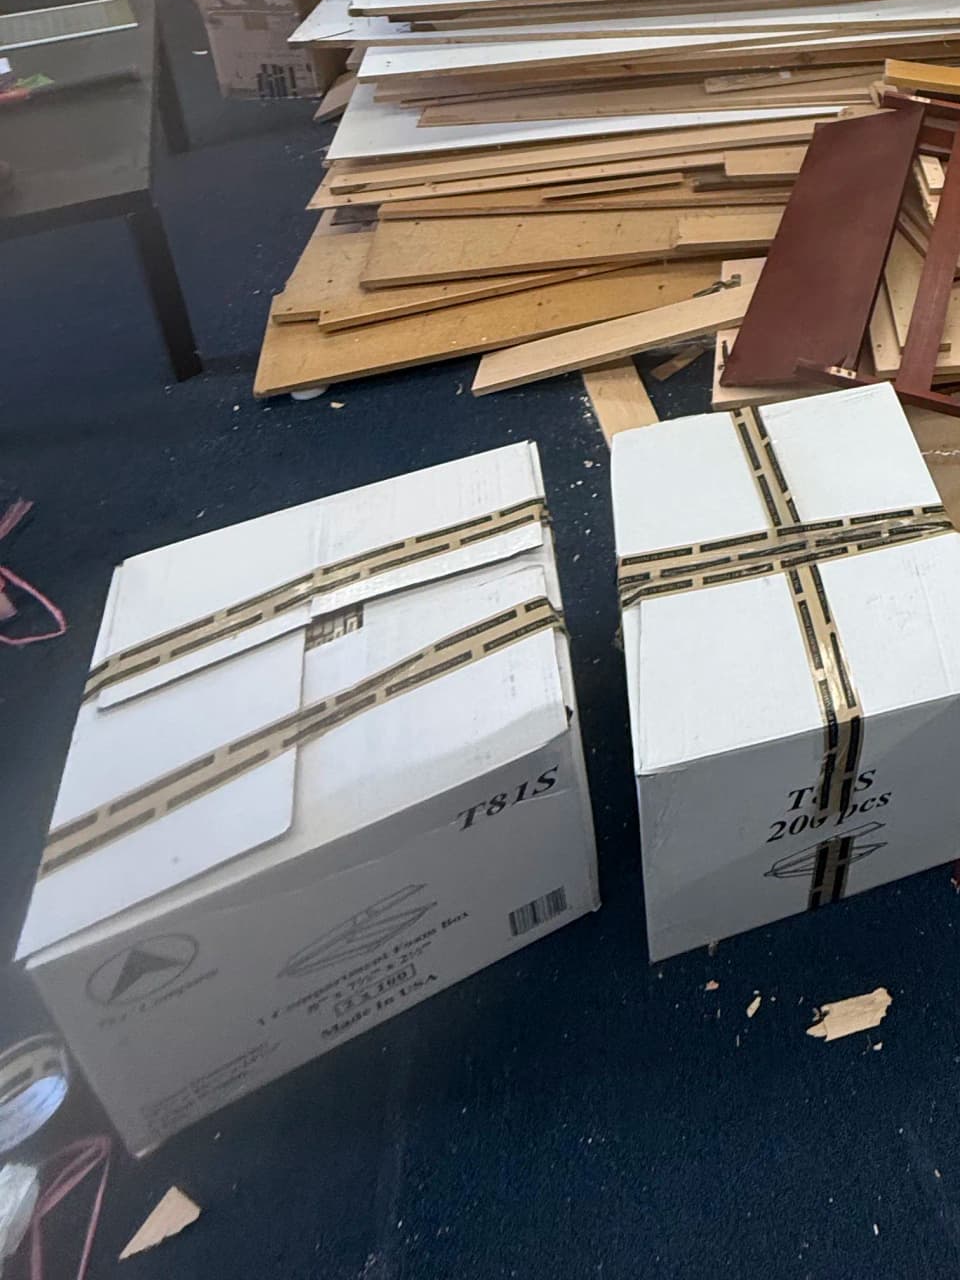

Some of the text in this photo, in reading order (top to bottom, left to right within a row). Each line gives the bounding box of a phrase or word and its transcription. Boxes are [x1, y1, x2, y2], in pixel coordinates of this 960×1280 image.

[457, 764, 560, 832] T81S
[786, 769, 877, 812] TS
[833, 791, 892, 827] pcs
